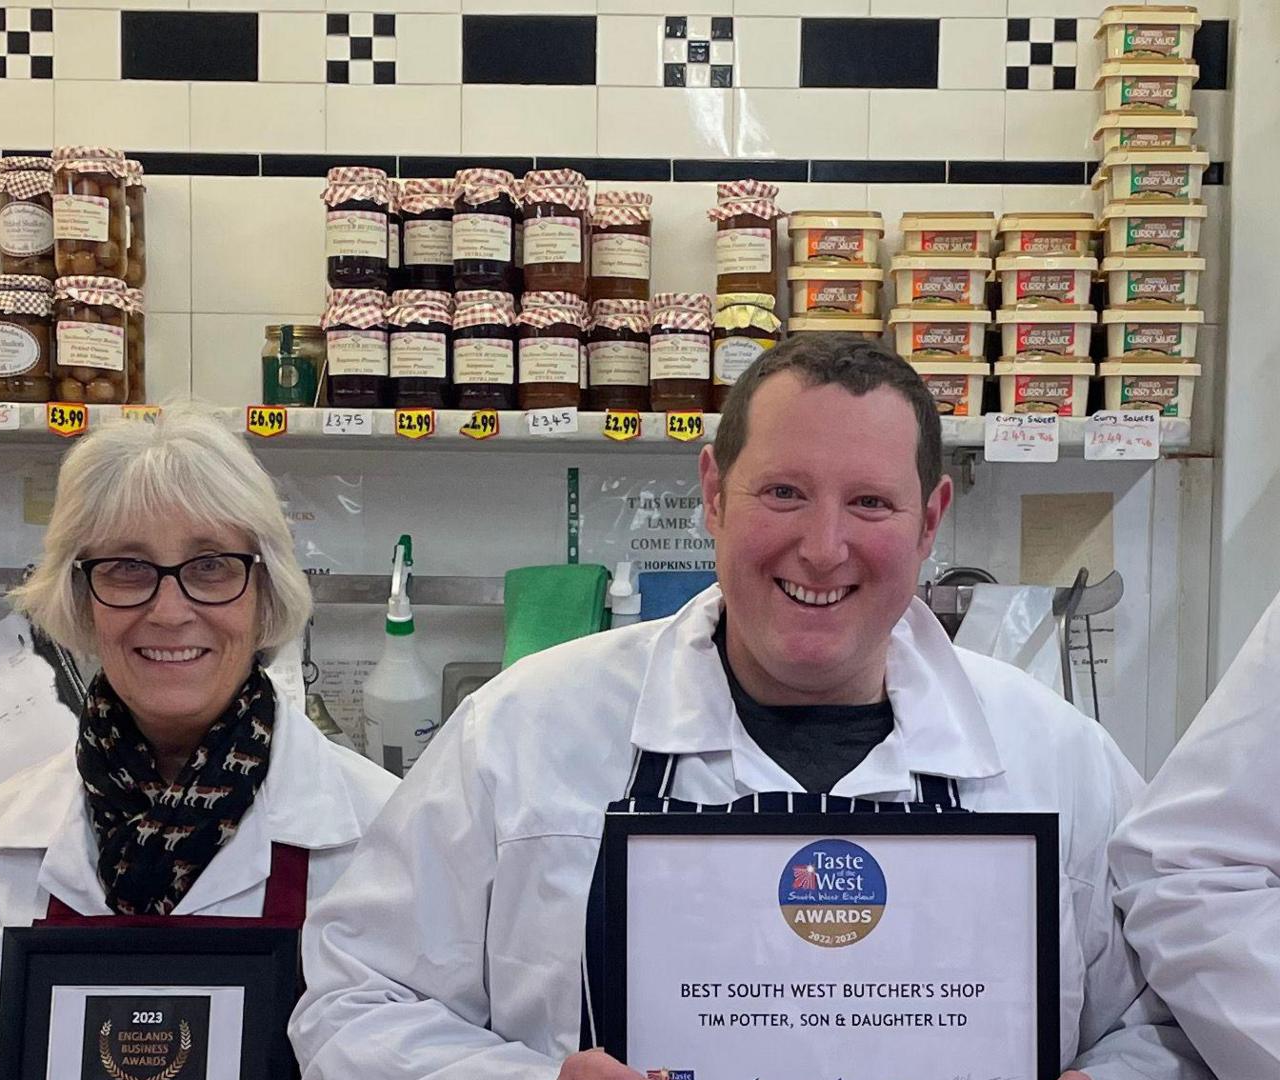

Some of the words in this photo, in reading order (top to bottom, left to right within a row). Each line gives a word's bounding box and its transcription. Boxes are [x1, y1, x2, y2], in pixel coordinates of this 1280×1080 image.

[51, 407, 83, 427] £3.99
[250, 410, 283, 431] £6.99
[398, 411, 431, 432] £2.99
[605, 414, 637, 433] £2.99
[669, 414, 702, 433] £2.99
[1093, 415, 1118, 424] Curry
[631, 538, 671, 550] COME
[674, 538, 716, 550] FROM
[644, 561, 692, 570] HOPKINS
[694, 561, 716, 570] LTD
[813, 851, 863, 870] Taste
[814, 872, 864, 891] West
[788, 891, 816, 902] South
[794, 909, 872, 923] AWARDS
[680, 983, 722, 998] BEST
[727, 983, 784, 998] SOUTH
[791, 983, 837, 998] WEST
[843, 983, 935, 998] BUTCHER'S
[941, 983, 985, 998] SHOP
[132, 1011, 163, 1024] 2023
[698, 1013, 725, 1027] TIM
[730, 1013, 795, 1030] POTTER,
[800, 1013, 830, 1027] SON
[835, 1013, 846, 1027] &
[851, 1013, 933, 1027] DAUGHTER
[938, 1013, 968, 1027] LTD
[118, 1030, 174, 1042] ENGLANDS
[121, 1043, 169, 1054] BUSINESS
[121, 1055, 167, 1066] AWARDS
